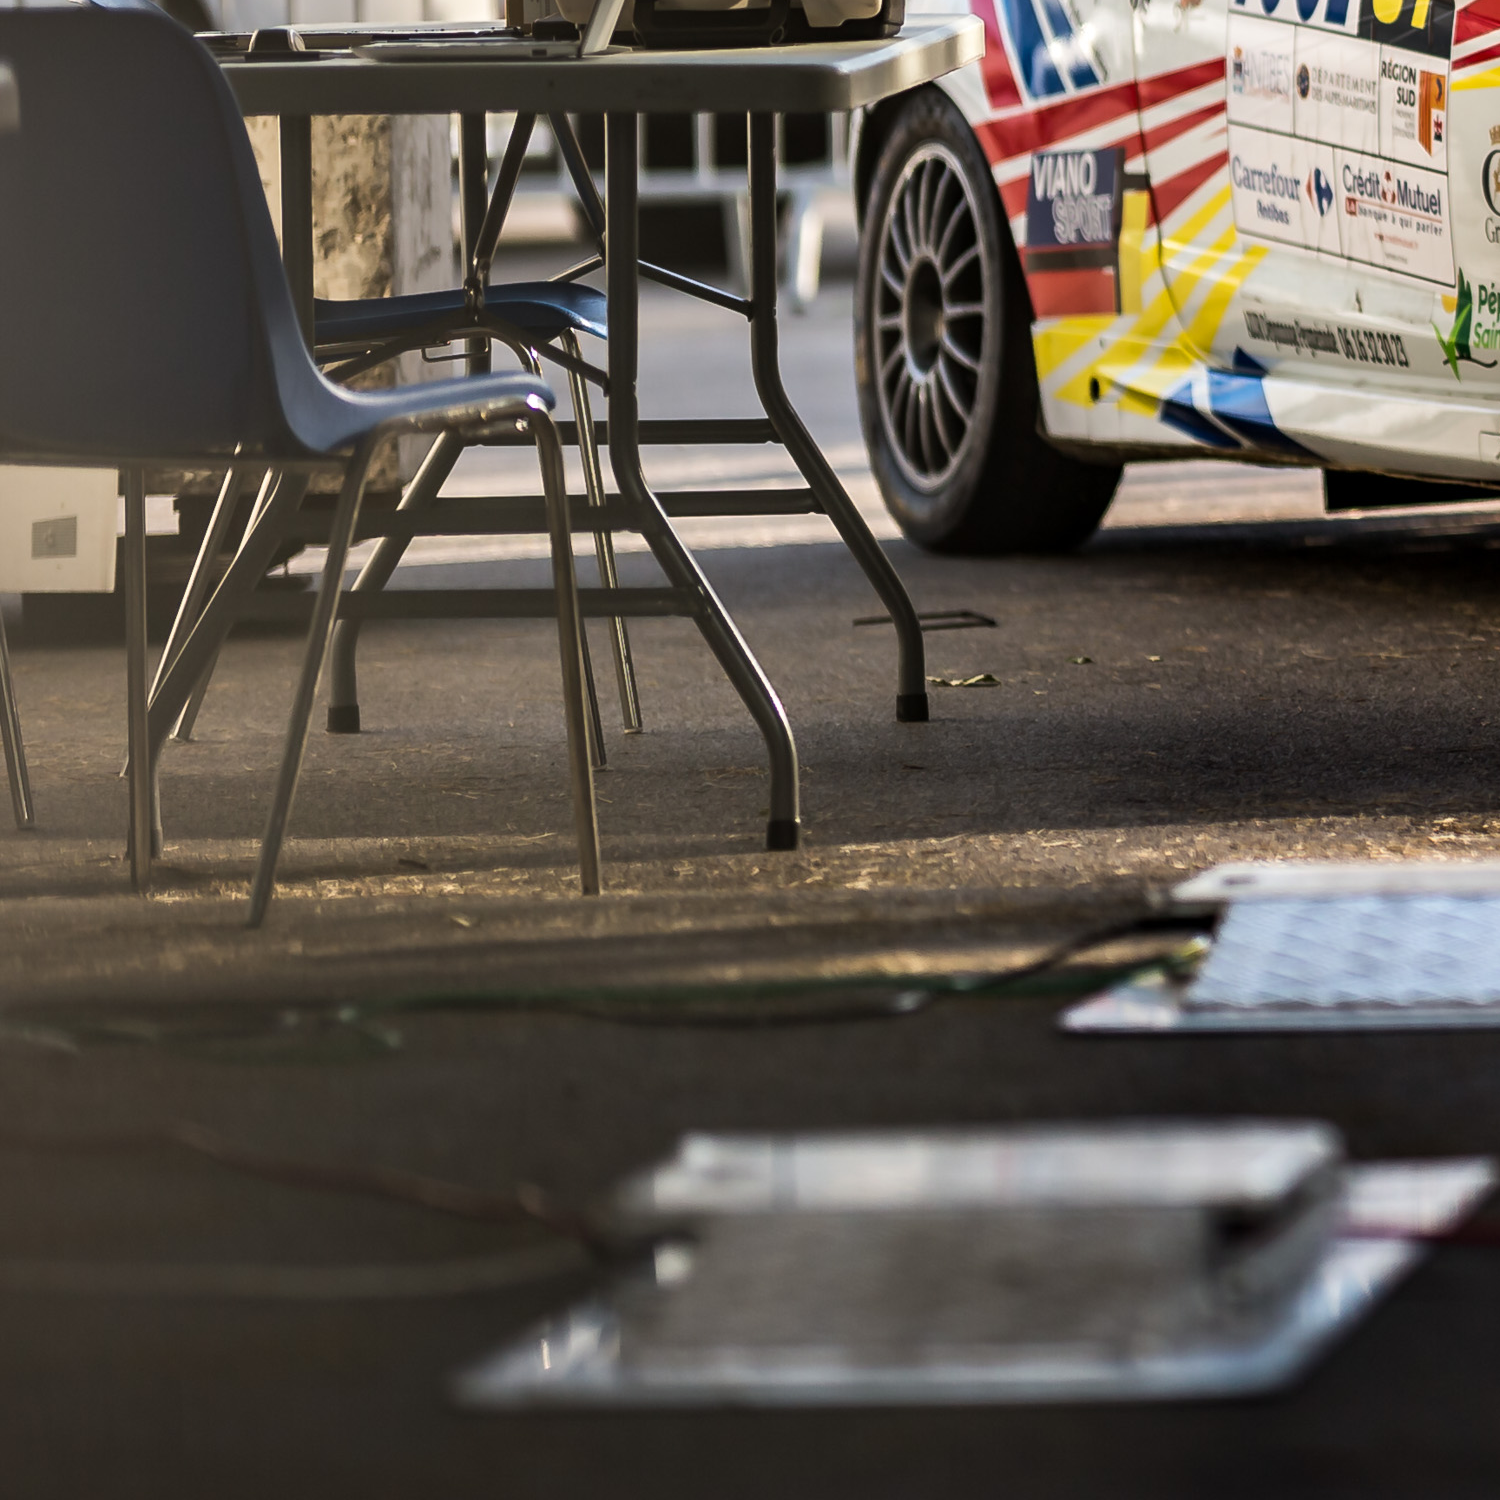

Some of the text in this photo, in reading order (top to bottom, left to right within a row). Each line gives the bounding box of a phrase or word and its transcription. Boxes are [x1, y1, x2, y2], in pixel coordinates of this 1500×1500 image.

[1312, 65, 1377, 96] DÉPARTEMENT
[1381, 57, 1416, 86] RÉGION
[1397, 86, 1416, 107] SUD
[1033, 152, 1097, 202] VIANO
[1232, 156, 1301, 201] Carrefour
[1342, 164, 1442, 217] Crédit Mutuel
[1052, 193, 1113, 245] SPORT
[1358, 204, 1388, 223] banque
[1399, 215, 1413, 230] qui
[1416, 218, 1443, 237] parler
